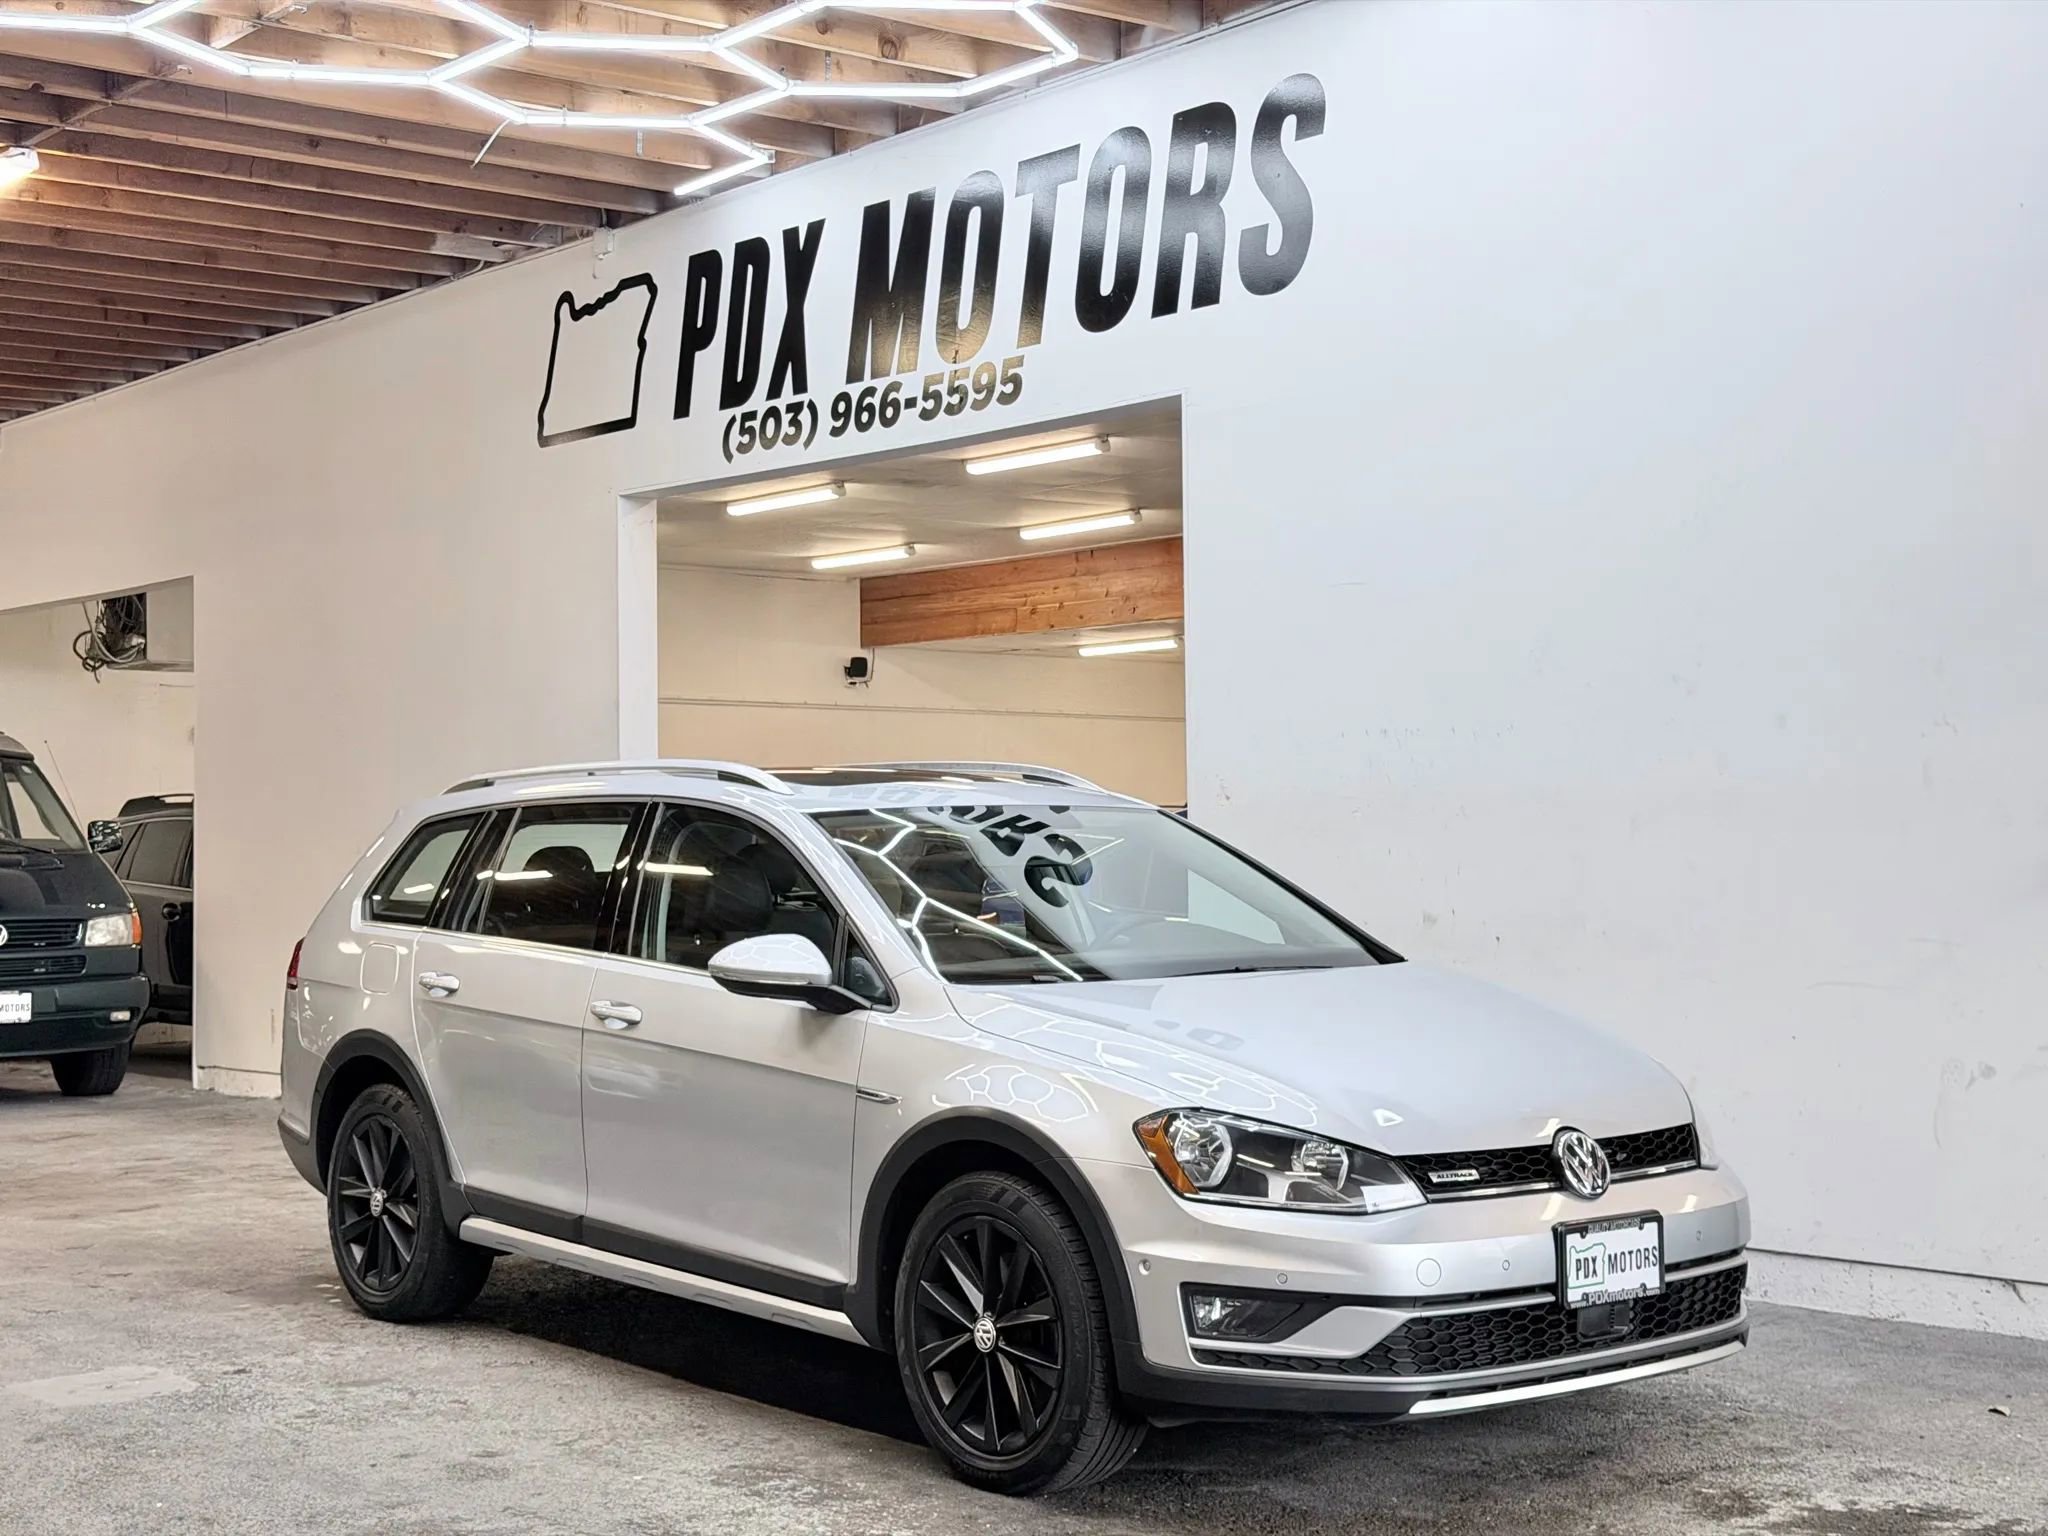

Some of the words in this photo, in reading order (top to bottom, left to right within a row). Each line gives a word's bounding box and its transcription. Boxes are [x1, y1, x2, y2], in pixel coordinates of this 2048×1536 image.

[673, 218, 826, 420] PDX
[846, 73, 1326, 385] MOTORS
[722, 400, 819, 463] (503)
[829, 356, 1024, 438] 966-5595
[1436, 1171, 1475, 1180] ALLTRACK
[1575, 1255, 1598, 1281] PDX
[1607, 1245, 1658, 1275] MOTORS
